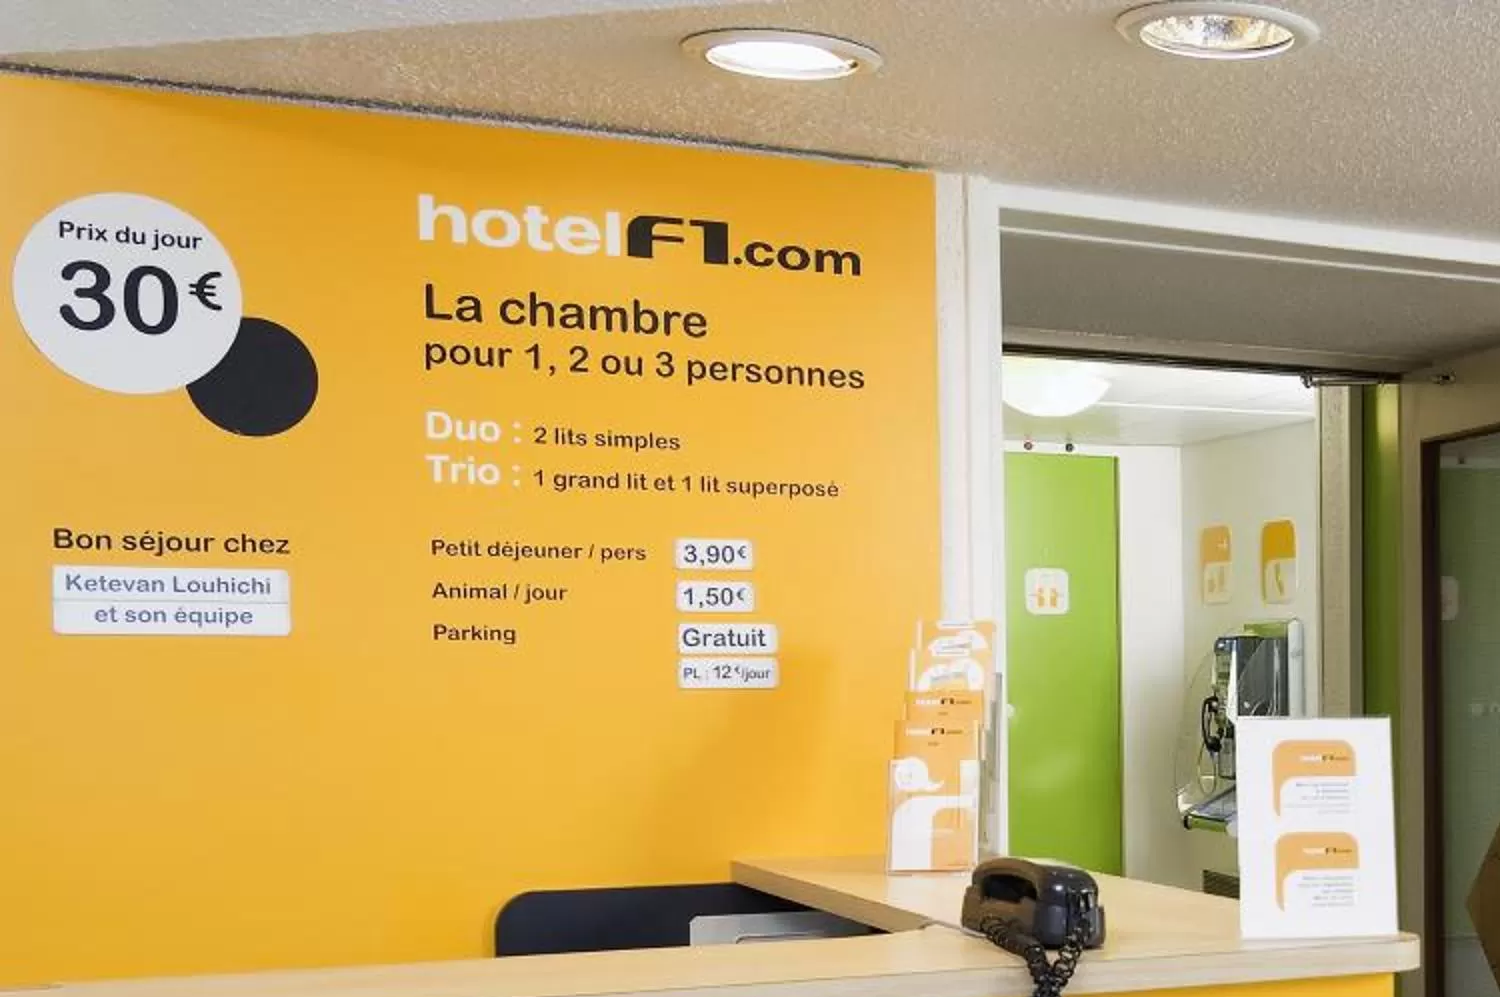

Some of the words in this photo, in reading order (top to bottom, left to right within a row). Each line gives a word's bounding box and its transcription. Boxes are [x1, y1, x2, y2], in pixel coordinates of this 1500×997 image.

[58, 220, 107, 243] Prix
[115, 226, 146, 246] du
[151, 229, 202, 251] jour
[417, 193, 862, 277] hotelF1.com
[425, 283, 483, 324] La
[499, 291, 708, 338] chambre
[425, 341, 512, 371] pour
[525, 343, 556, 377] 1,
[569, 345, 590, 373] 2
[601, 353, 643, 376] ou
[655, 351, 675, 378] 3
[686, 357, 865, 390] personnes
[425, 410, 501, 443] Duo
[533, 427, 547, 445] 2
[553, 428, 588, 447] lits
[594, 430, 681, 452] simples
[424, 455, 501, 486] Trio
[534, 470, 544, 487] 1
[553, 472, 619, 494] grand
[626, 473, 647, 491] lit
[653, 475, 675, 491] et
[681, 475, 691, 492] 1
[699, 475, 720, 494] lit
[725, 479, 839, 500] superposé
[52, 528, 112, 551] Bon
[122, 529, 215, 557] séjour
[223, 533, 290, 555] chez
[431, 539, 481, 557] Petit
[487, 540, 582, 562] déjeuner
[600, 546, 646, 563] pers
[684, 544, 747, 566] 3,90€
[64, 574, 165, 594] Ketevan
[173, 575, 272, 596] Louhichi
[432, 582, 507, 600] Animal
[524, 585, 568, 604] jour
[94, 608, 118, 623] et
[125, 610, 167, 624] son
[174, 607, 254, 628] équipe
[433, 624, 516, 644] Parking
[683, 627, 767, 647] Gratuit
[683, 667, 700, 679] PL
